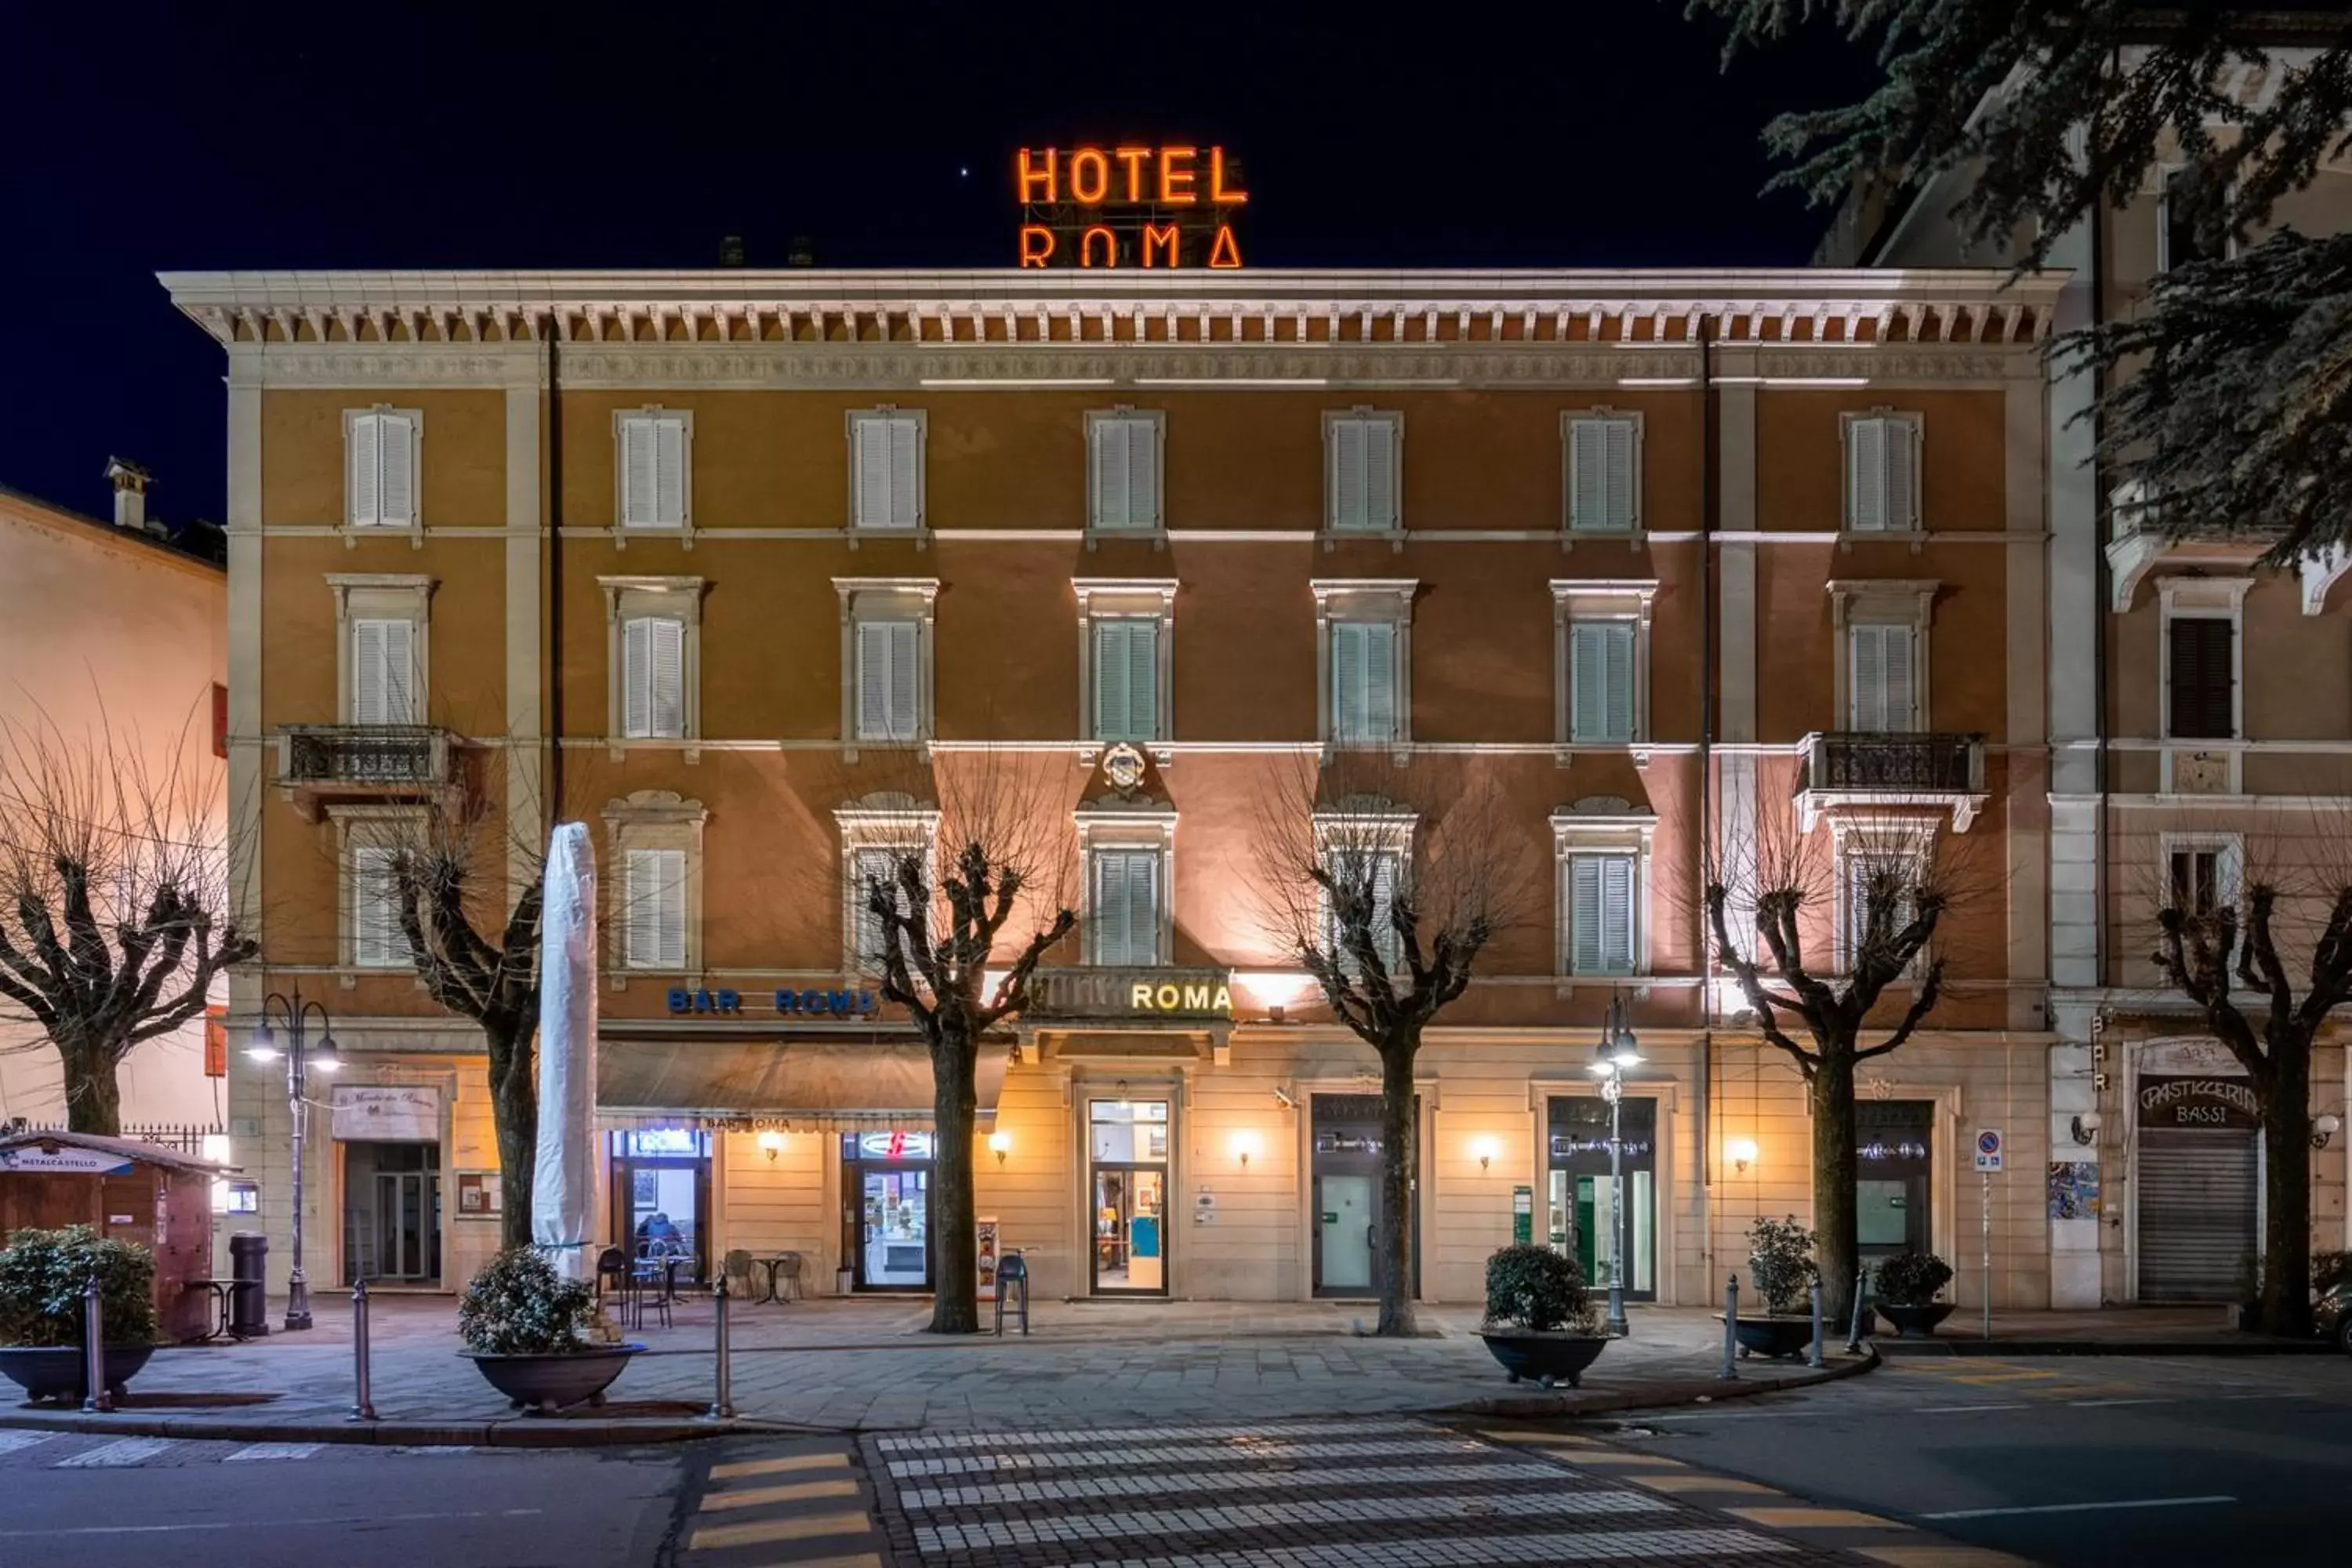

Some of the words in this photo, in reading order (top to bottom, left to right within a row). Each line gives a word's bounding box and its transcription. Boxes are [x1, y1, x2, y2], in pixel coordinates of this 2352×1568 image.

[1019, 146, 1249, 204] HOTEL
[1020, 225, 1243, 268] ROMA
[667, 986, 739, 1014] BAR
[775, 988, 875, 1014] ROMA
[1132, 984, 1234, 1010] ROMA
[2092, 1015, 2106, 1091] BAR
[2140, 1080, 2261, 1116] PASTICCERIA
[707, 1118, 736, 1128] BAR
[2176, 1105, 2227, 1123] BASSI
[22, 1159, 98, 1167] METALCASTELLO
